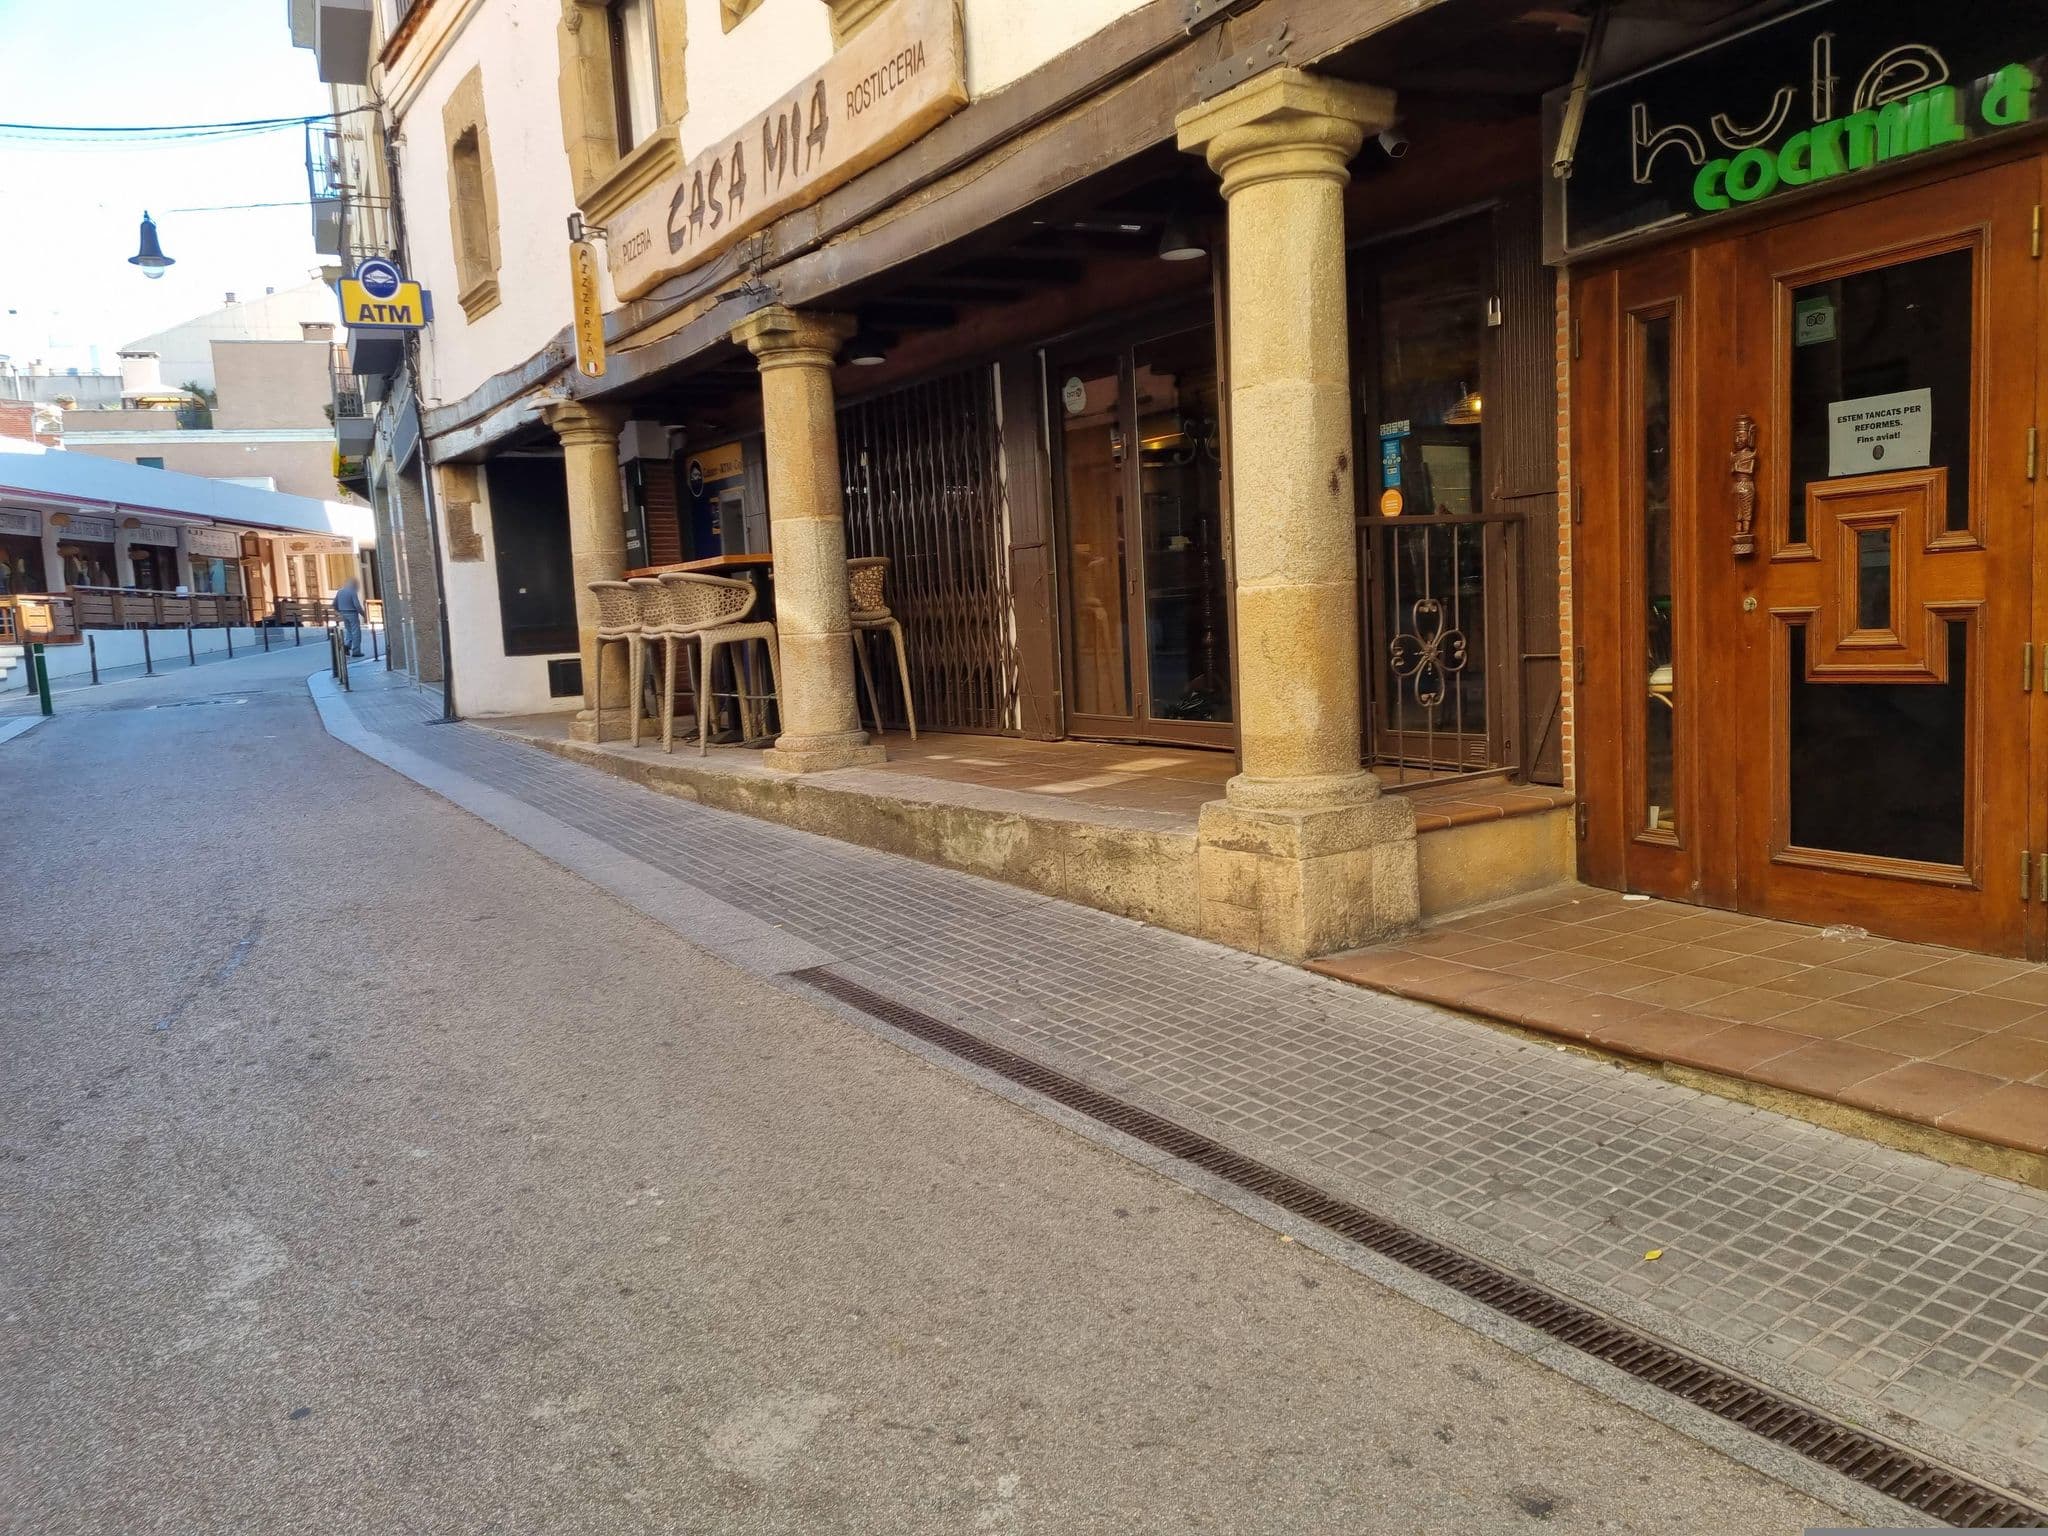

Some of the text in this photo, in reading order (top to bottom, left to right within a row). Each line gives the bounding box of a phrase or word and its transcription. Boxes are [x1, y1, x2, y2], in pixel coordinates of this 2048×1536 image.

[847, 40, 926, 120] ROSTICCERIA
[1694, 85, 1965, 211] COCKTAIL
[667, 79, 829, 255] CASA MIA
[622, 227, 652, 264] PIZZERIA
[359, 303, 412, 323] ATM
[579, 249, 595, 356] PIZZERIA
[1837, 404, 1922, 424] ESTEM TANCATS PER
[1854, 419, 1903, 432] REFORMES.
[1856, 431, 1901, 444] Fins aviat!
